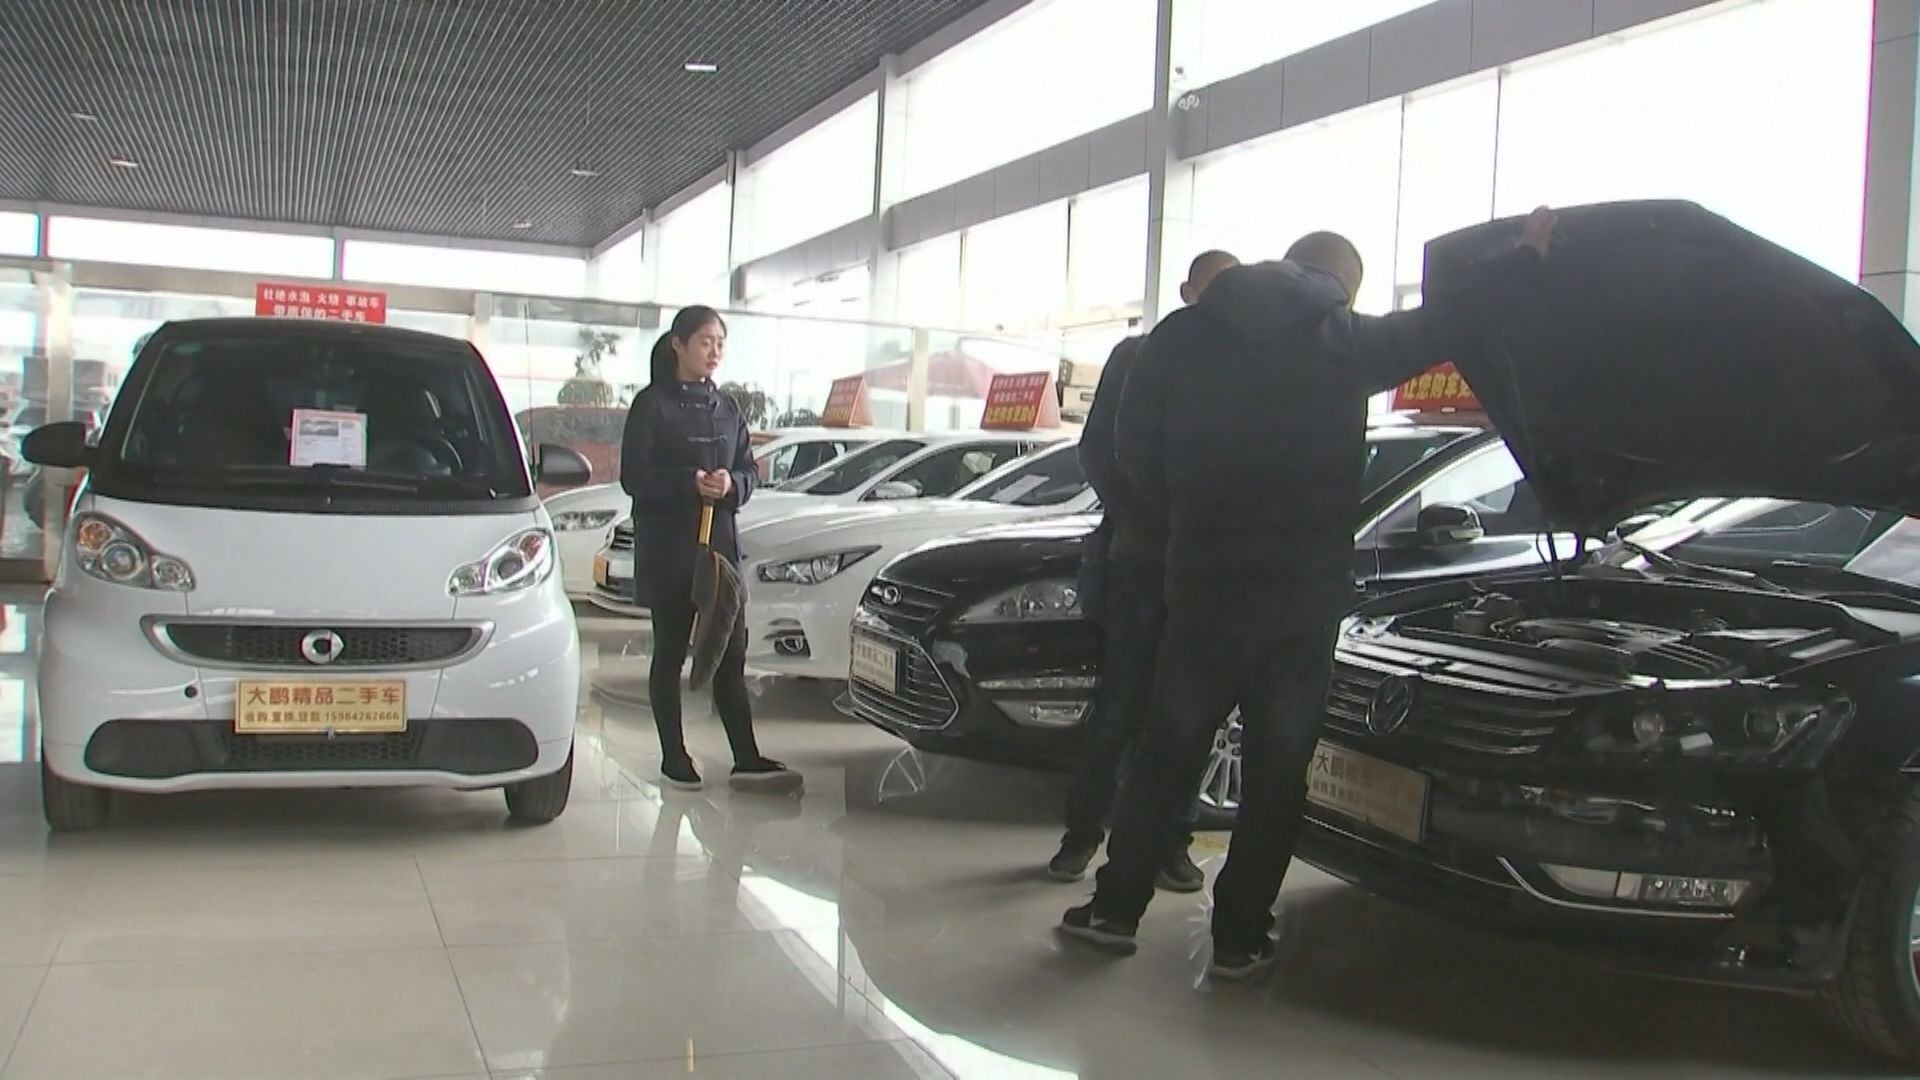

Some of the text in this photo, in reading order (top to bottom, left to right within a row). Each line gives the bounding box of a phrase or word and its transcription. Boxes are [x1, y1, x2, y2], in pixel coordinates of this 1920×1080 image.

[247, 686, 400, 706] 大鹏精品二手车
